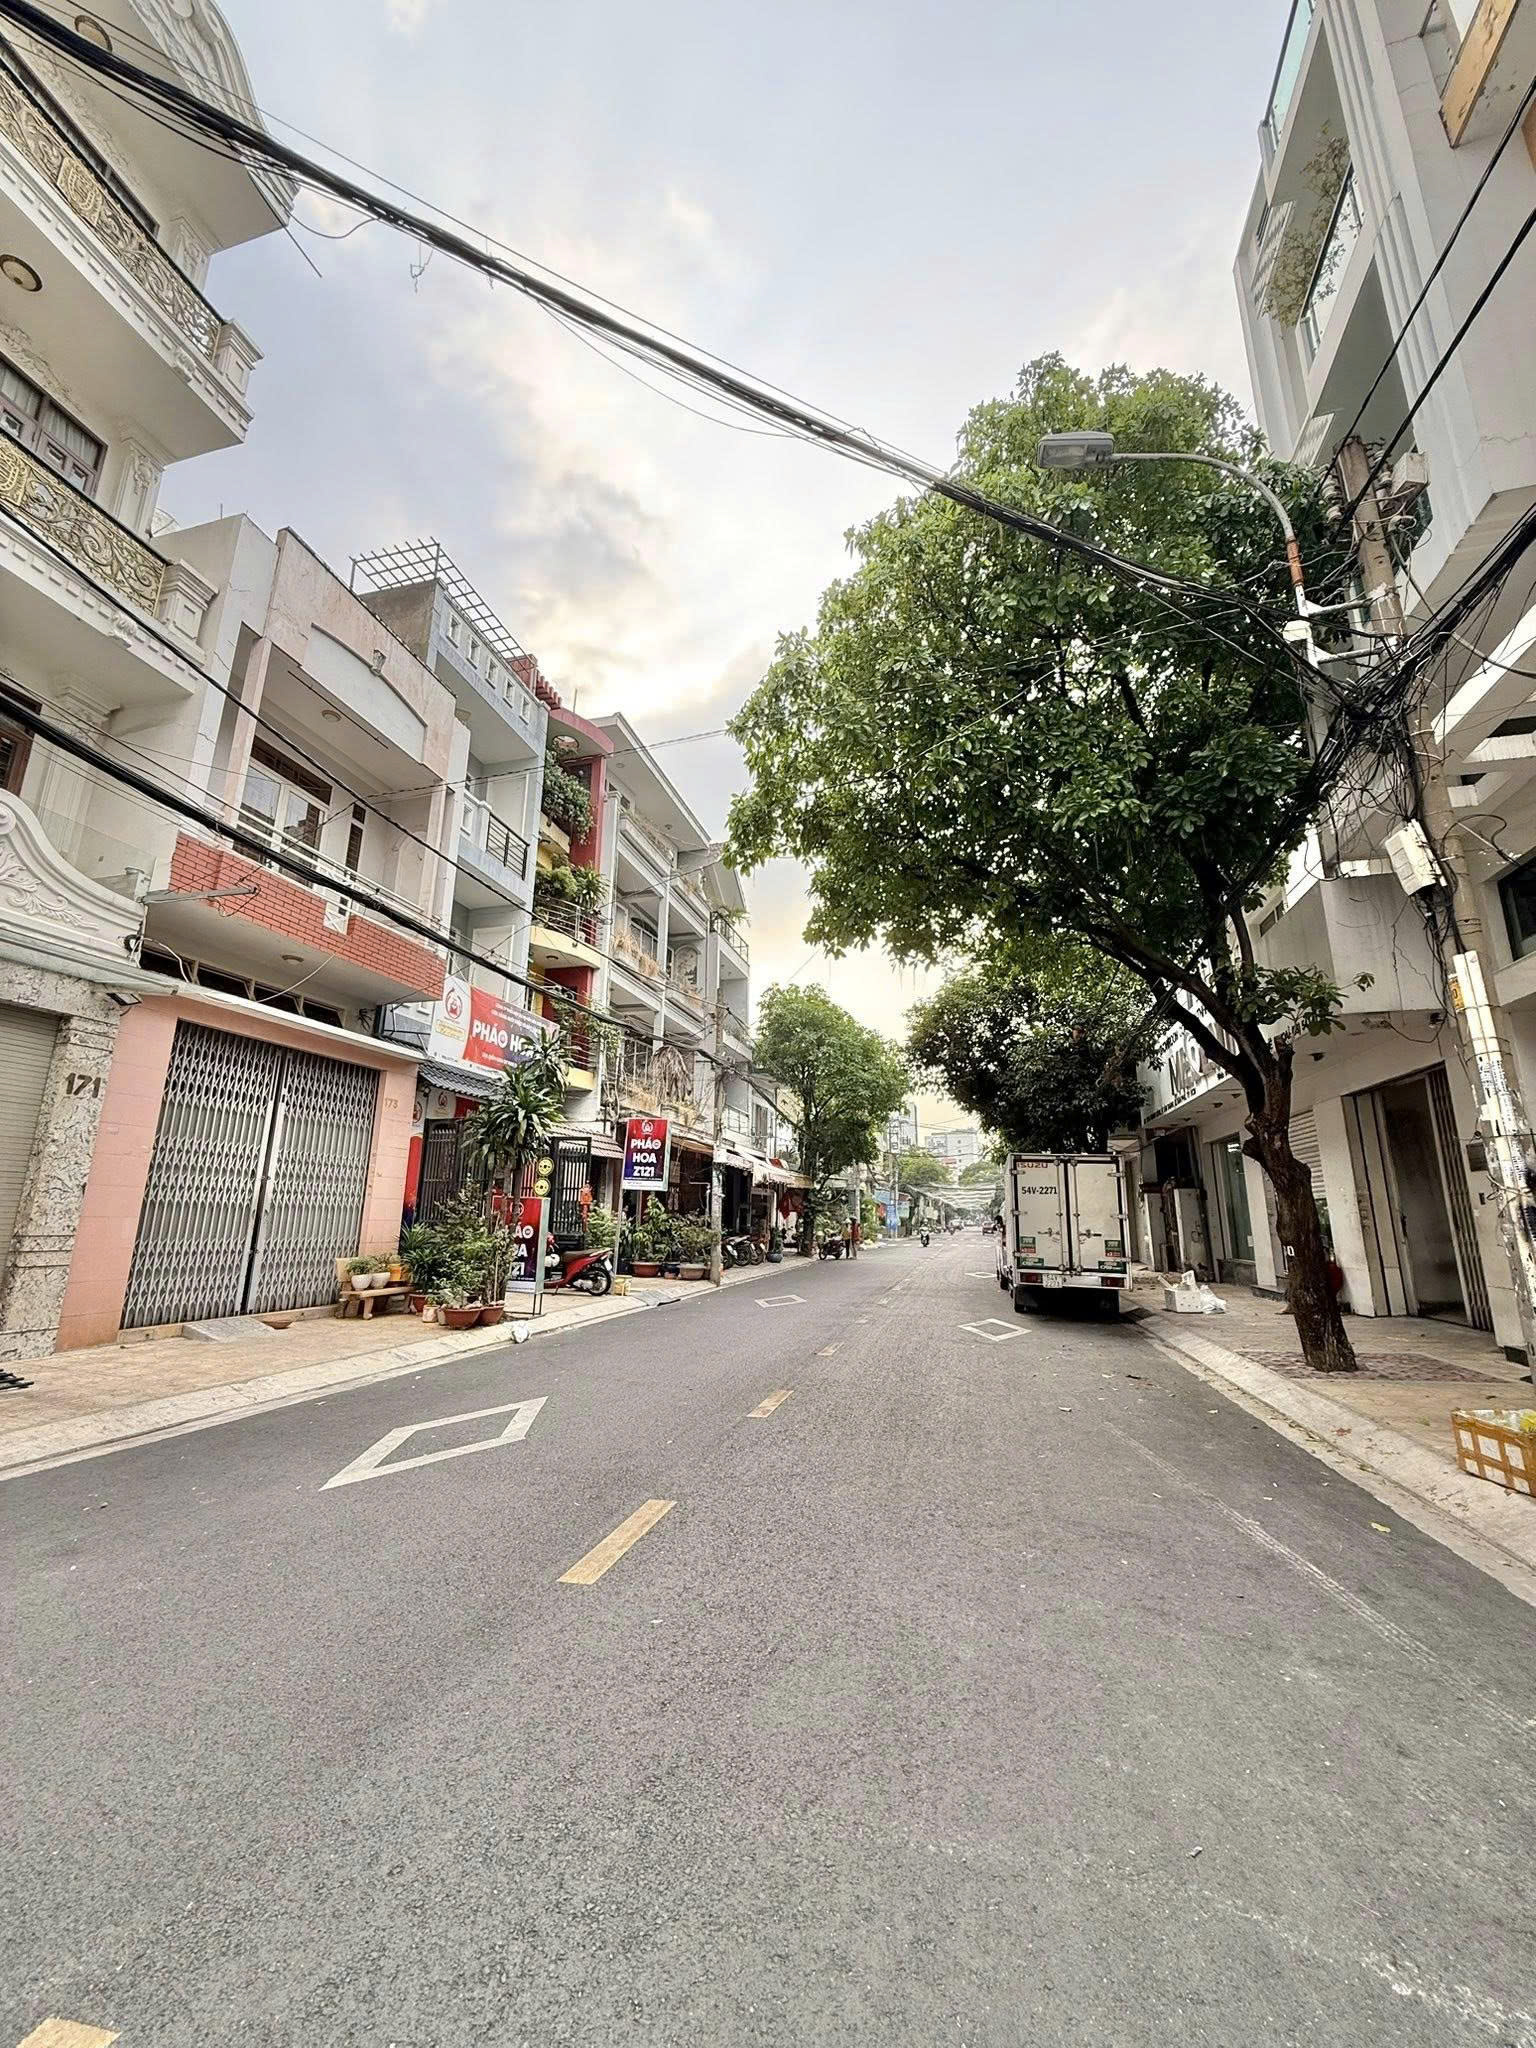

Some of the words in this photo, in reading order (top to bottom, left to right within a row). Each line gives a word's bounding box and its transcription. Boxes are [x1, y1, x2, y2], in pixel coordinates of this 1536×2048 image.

[472, 1019, 508, 1049] PHÁO
[65, 1072, 101, 1098] 171
[385, 1098, 399, 1109] 173
[630, 1137, 662, 1150] PHÁO
[632, 1152, 657, 1163] HOA
[633, 1166, 655, 1177] Z121
[1021, 1186, 1058, 1195] 54V-2271
[514, 1222, 535, 1239] ÁO
[511, 1261, 526, 1277] 21
